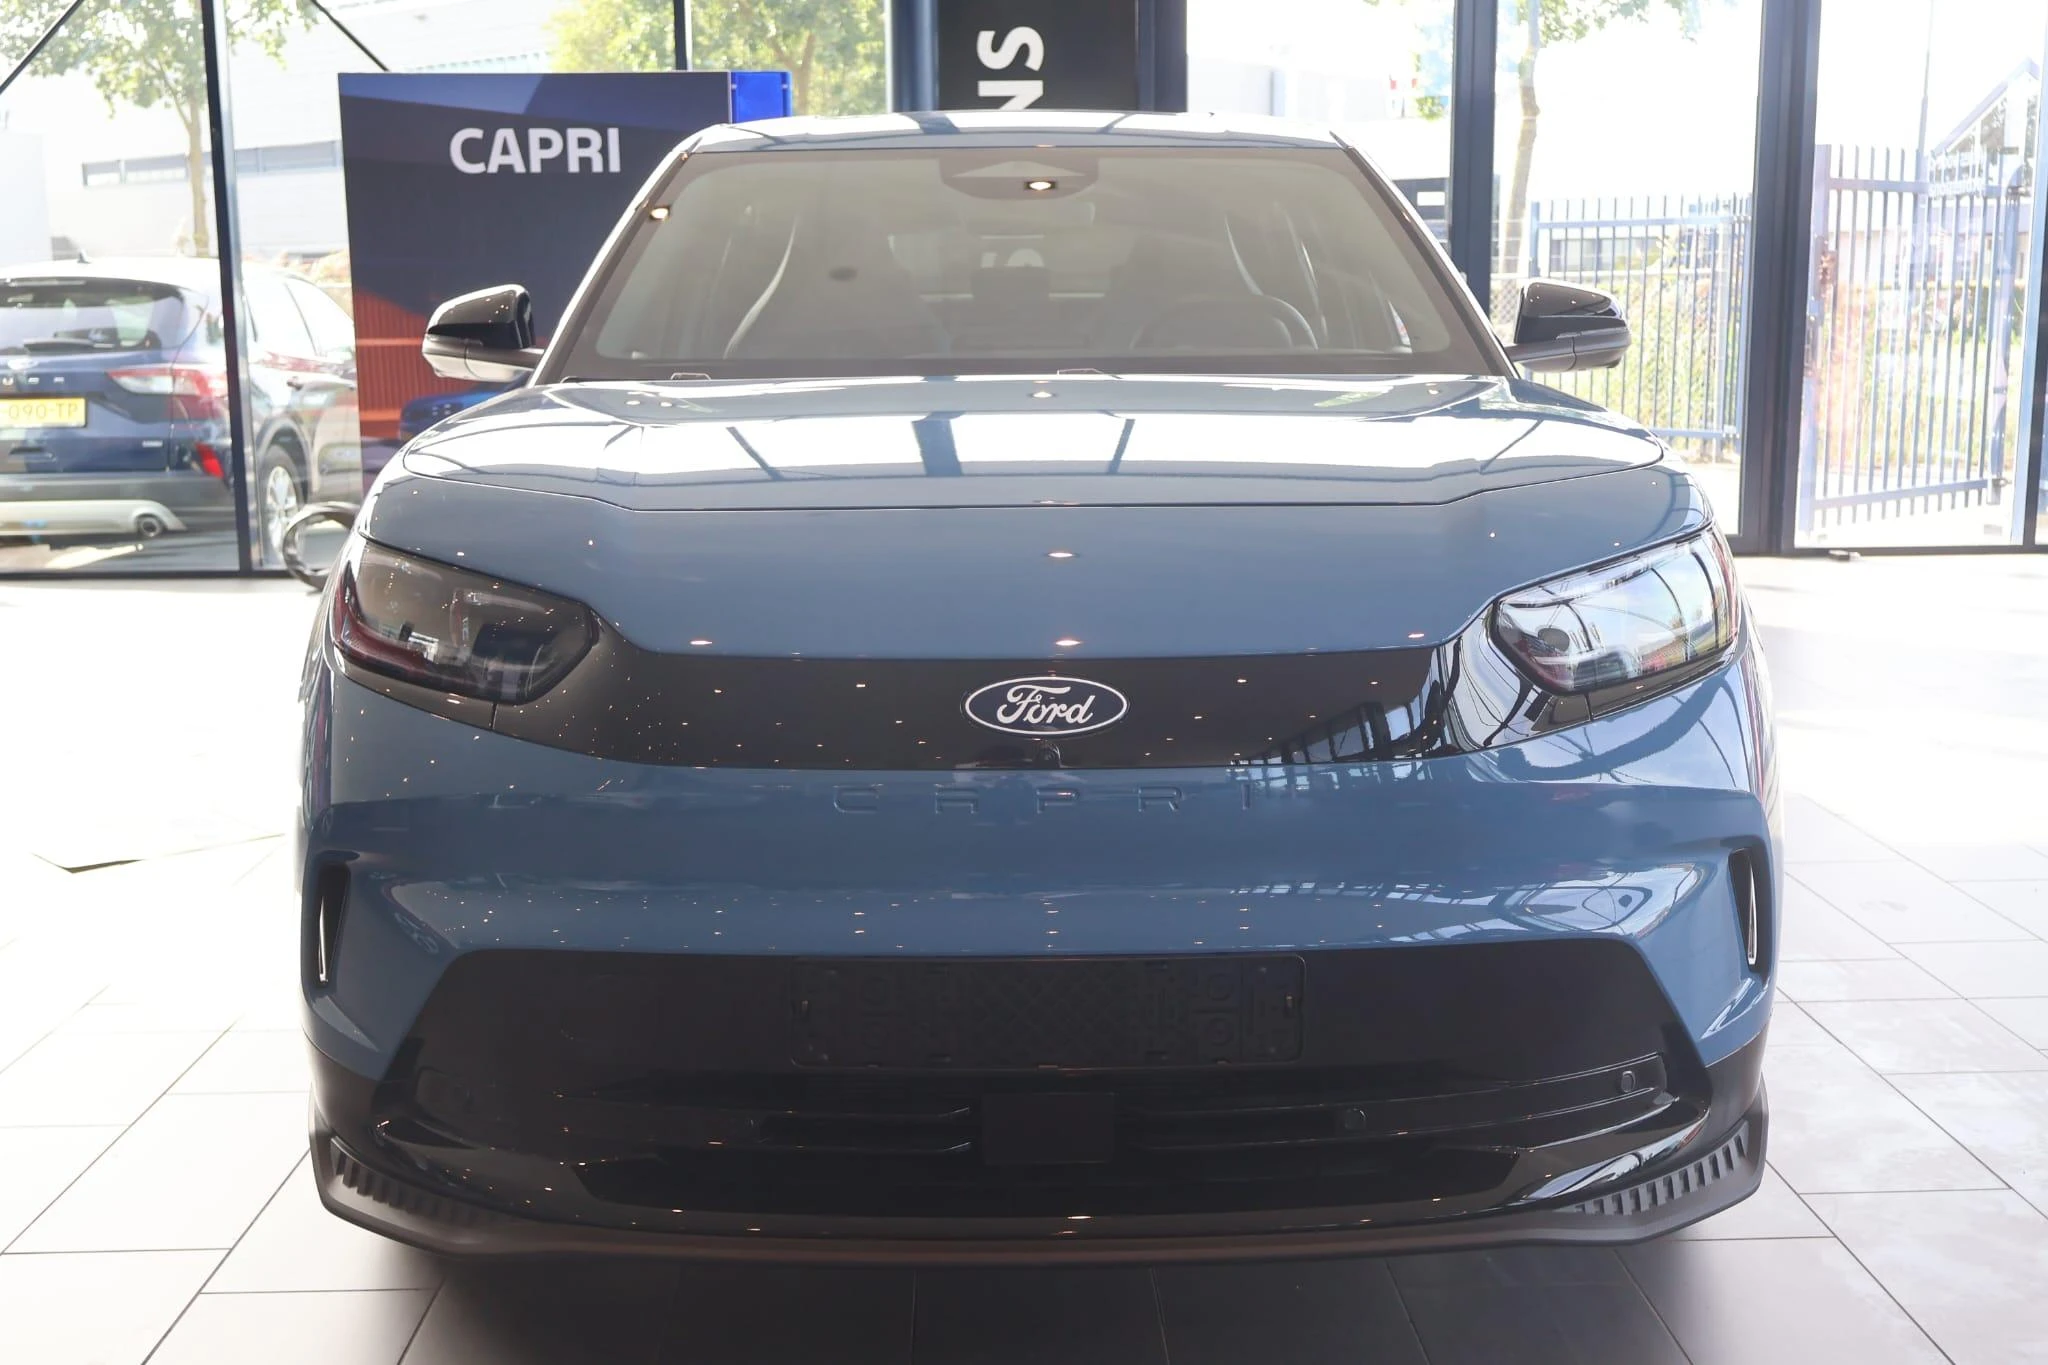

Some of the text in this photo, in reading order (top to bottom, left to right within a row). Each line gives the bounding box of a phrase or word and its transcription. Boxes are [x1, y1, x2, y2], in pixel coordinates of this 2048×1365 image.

[450, 127, 621, 174] CAPRI
[997, 684, 1096, 724] Ford
[832, 783, 1250, 814] CAPRI
